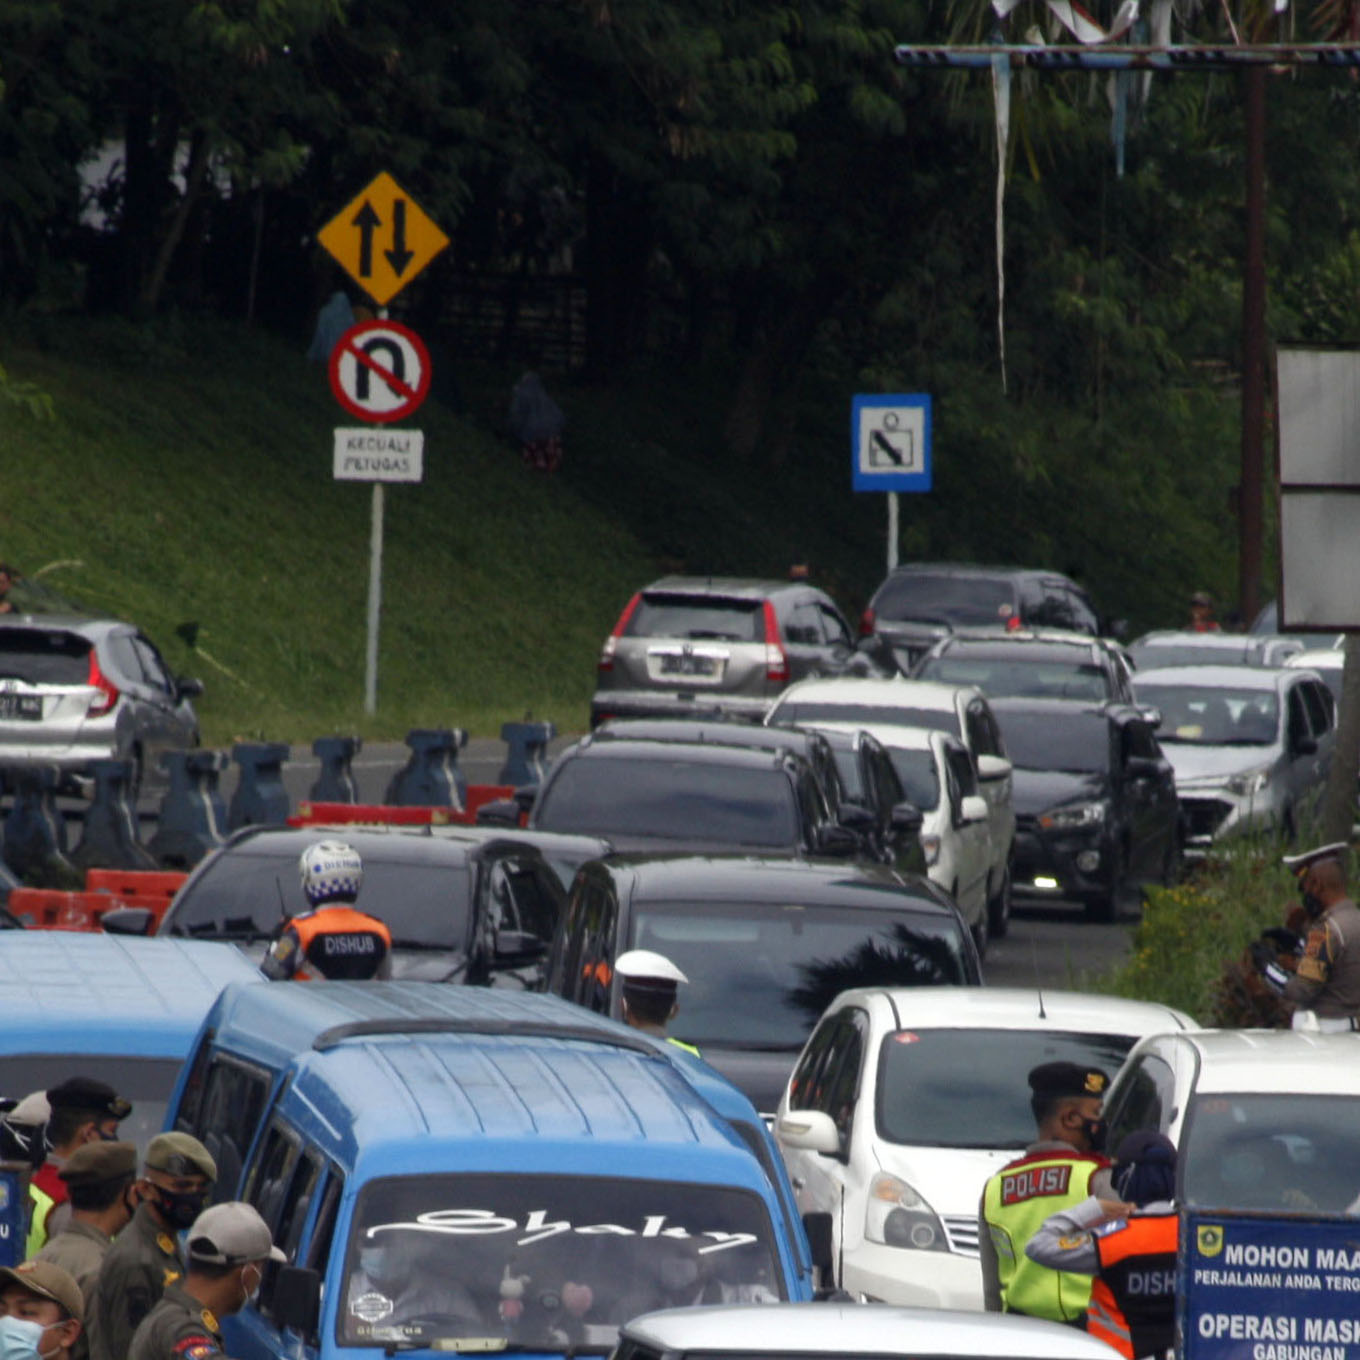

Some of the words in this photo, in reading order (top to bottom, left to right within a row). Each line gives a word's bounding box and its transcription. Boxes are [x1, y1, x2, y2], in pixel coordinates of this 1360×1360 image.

[346, 437, 411, 454] KECUALI
[324, 935, 375, 955] DISHUB
[1003, 1167, 1066, 1201] POLISI
[1225, 1244, 1309, 1269] MOHON
[1194, 1269, 1281, 1288] PERJALANAN
[1285, 1274, 1322, 1290] ANDA
[1198, 1313, 1297, 1341] OPERASI
